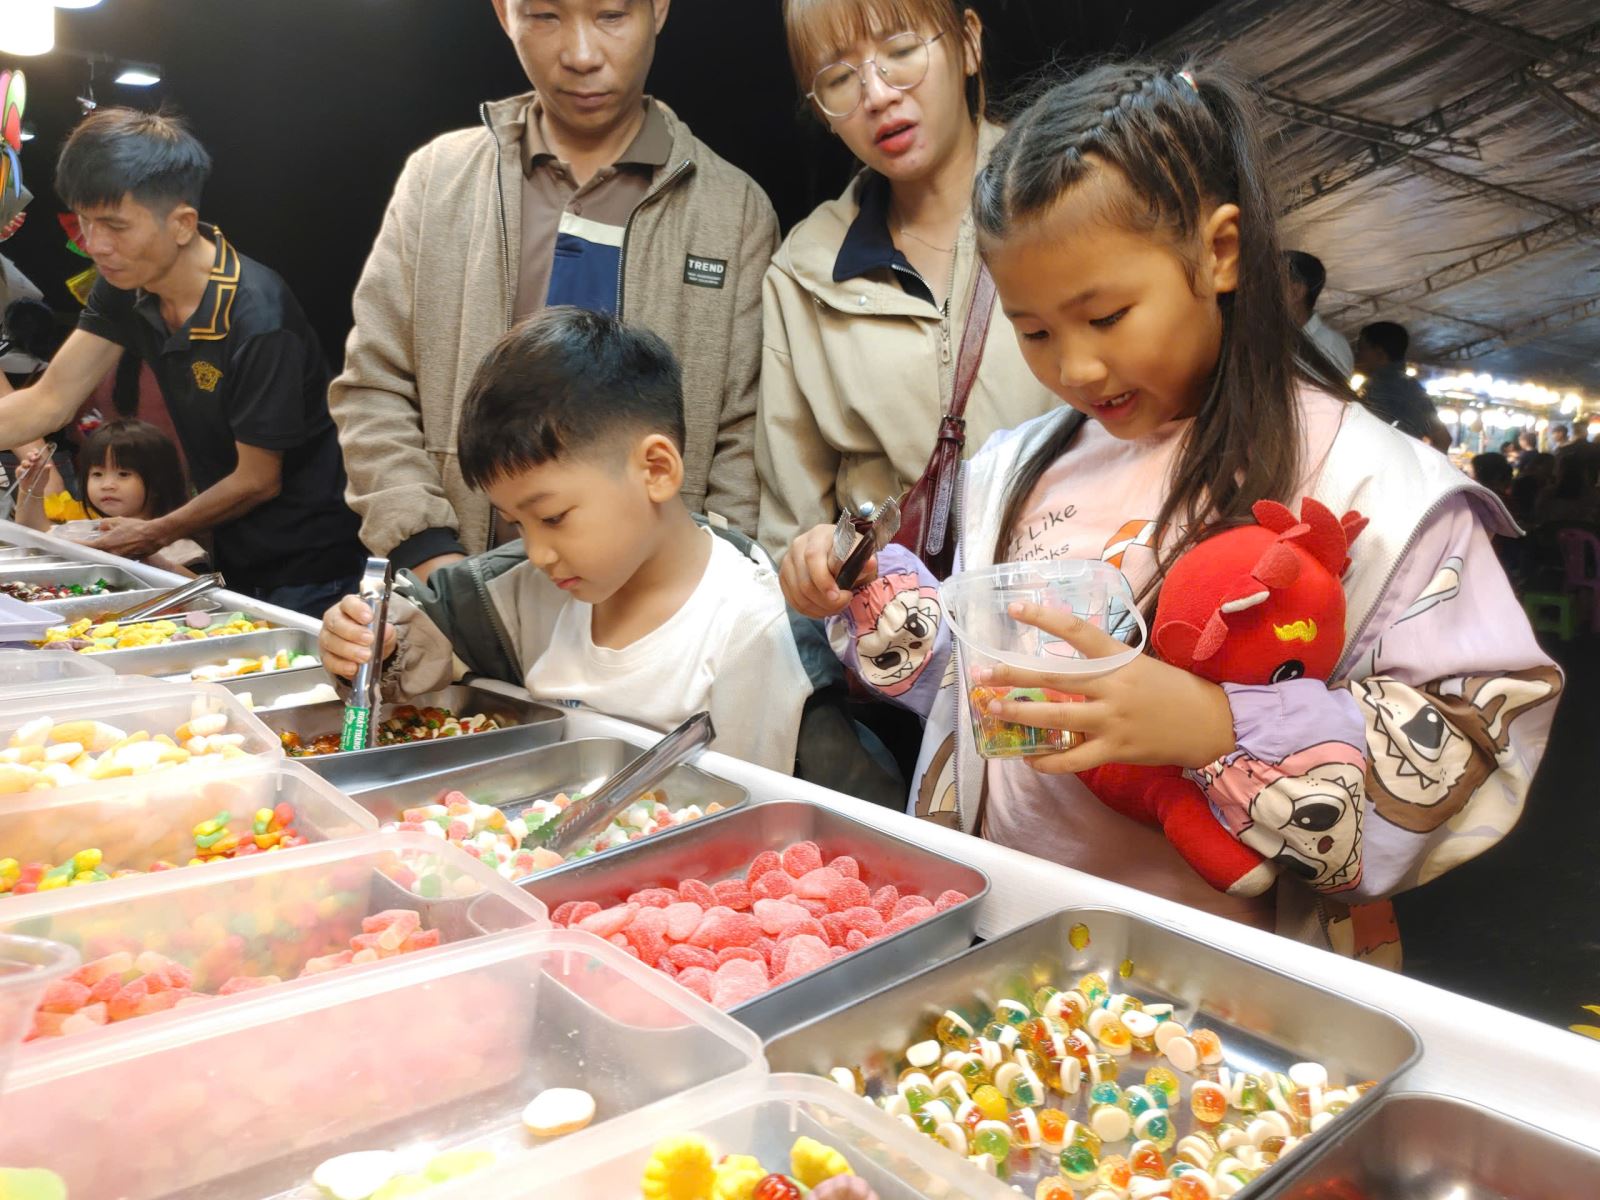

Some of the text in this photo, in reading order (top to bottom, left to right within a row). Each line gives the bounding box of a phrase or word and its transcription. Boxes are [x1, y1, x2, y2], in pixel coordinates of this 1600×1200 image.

[688, 259, 724, 274] TREND
[1014, 504, 1077, 553] I Like
